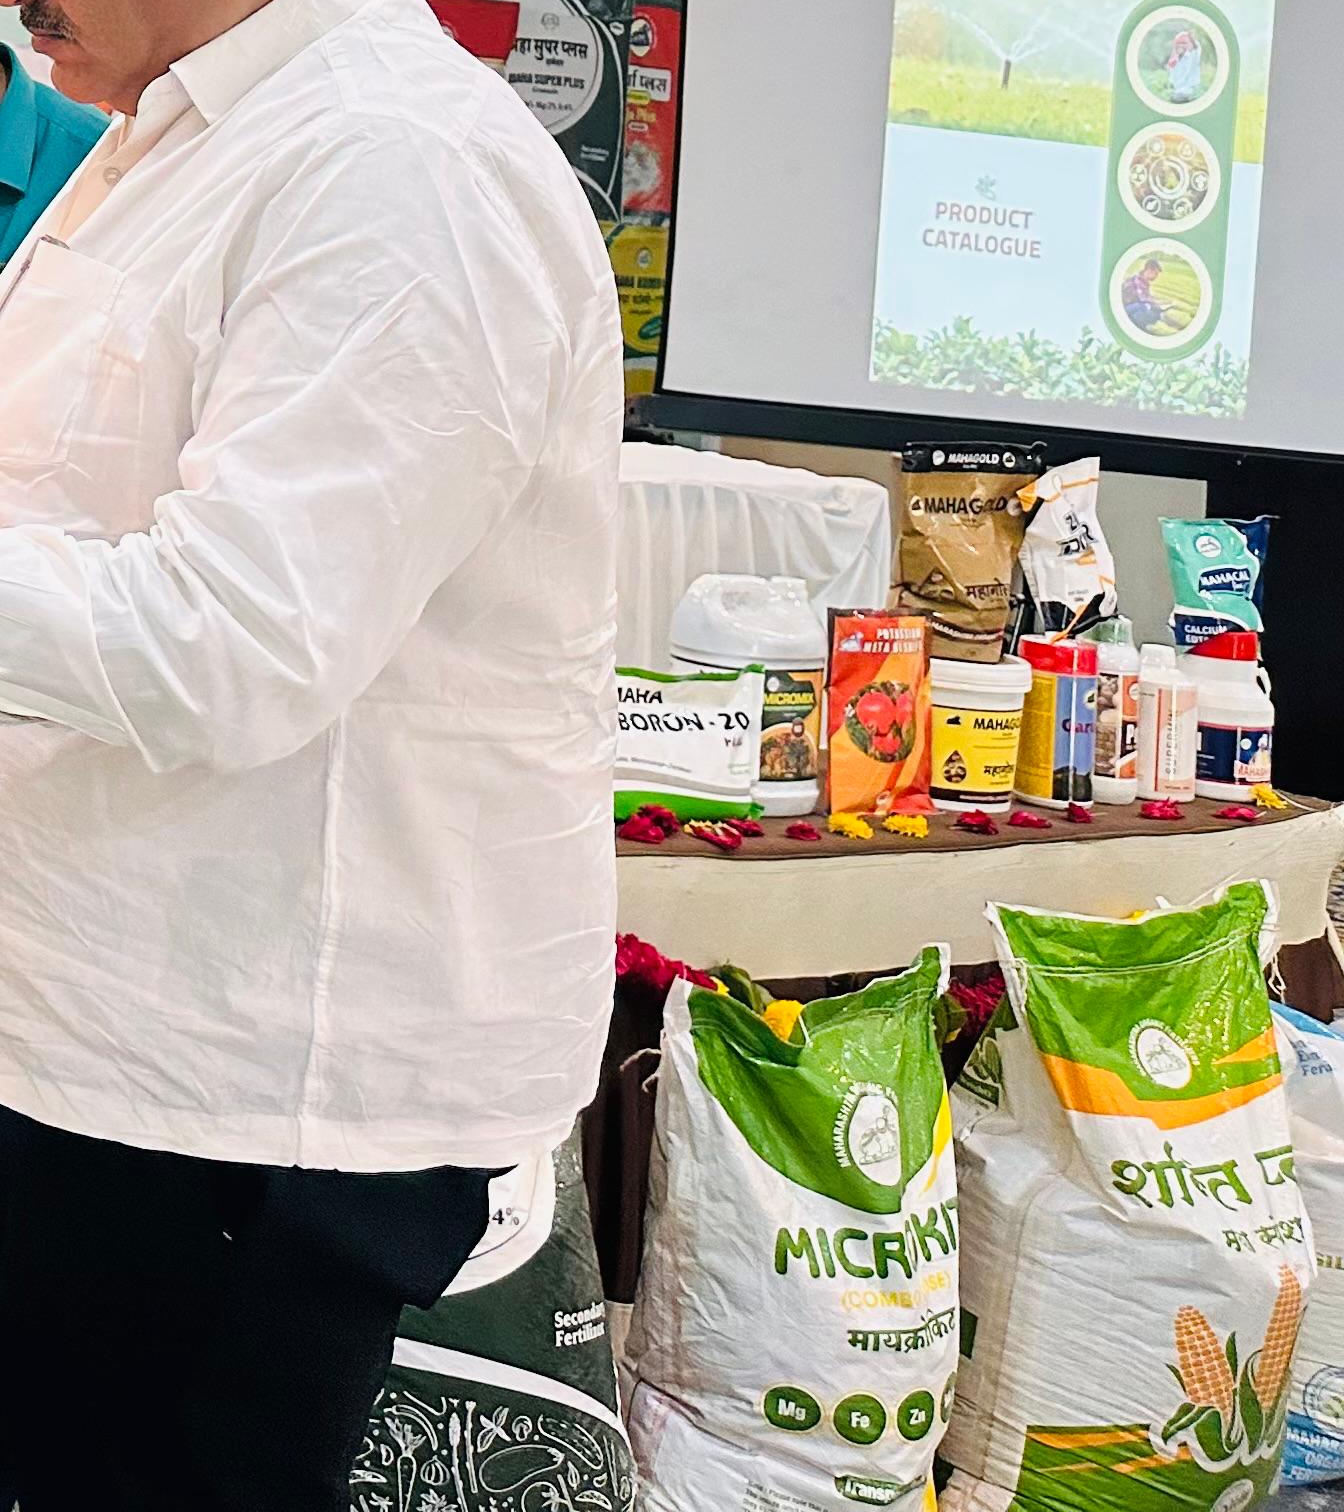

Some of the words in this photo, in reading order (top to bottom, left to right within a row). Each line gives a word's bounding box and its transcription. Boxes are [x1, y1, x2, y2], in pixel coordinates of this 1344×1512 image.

[935, 201, 1034, 230] PRODUCT
[922, 228, 1042, 259] CATALOGUE
[618, 711, 705, 733] BORON
[717, 711, 750, 730] 20
[778, 1398, 806, 1422] Mg
[851, 1411, 871, 1429] Fe
